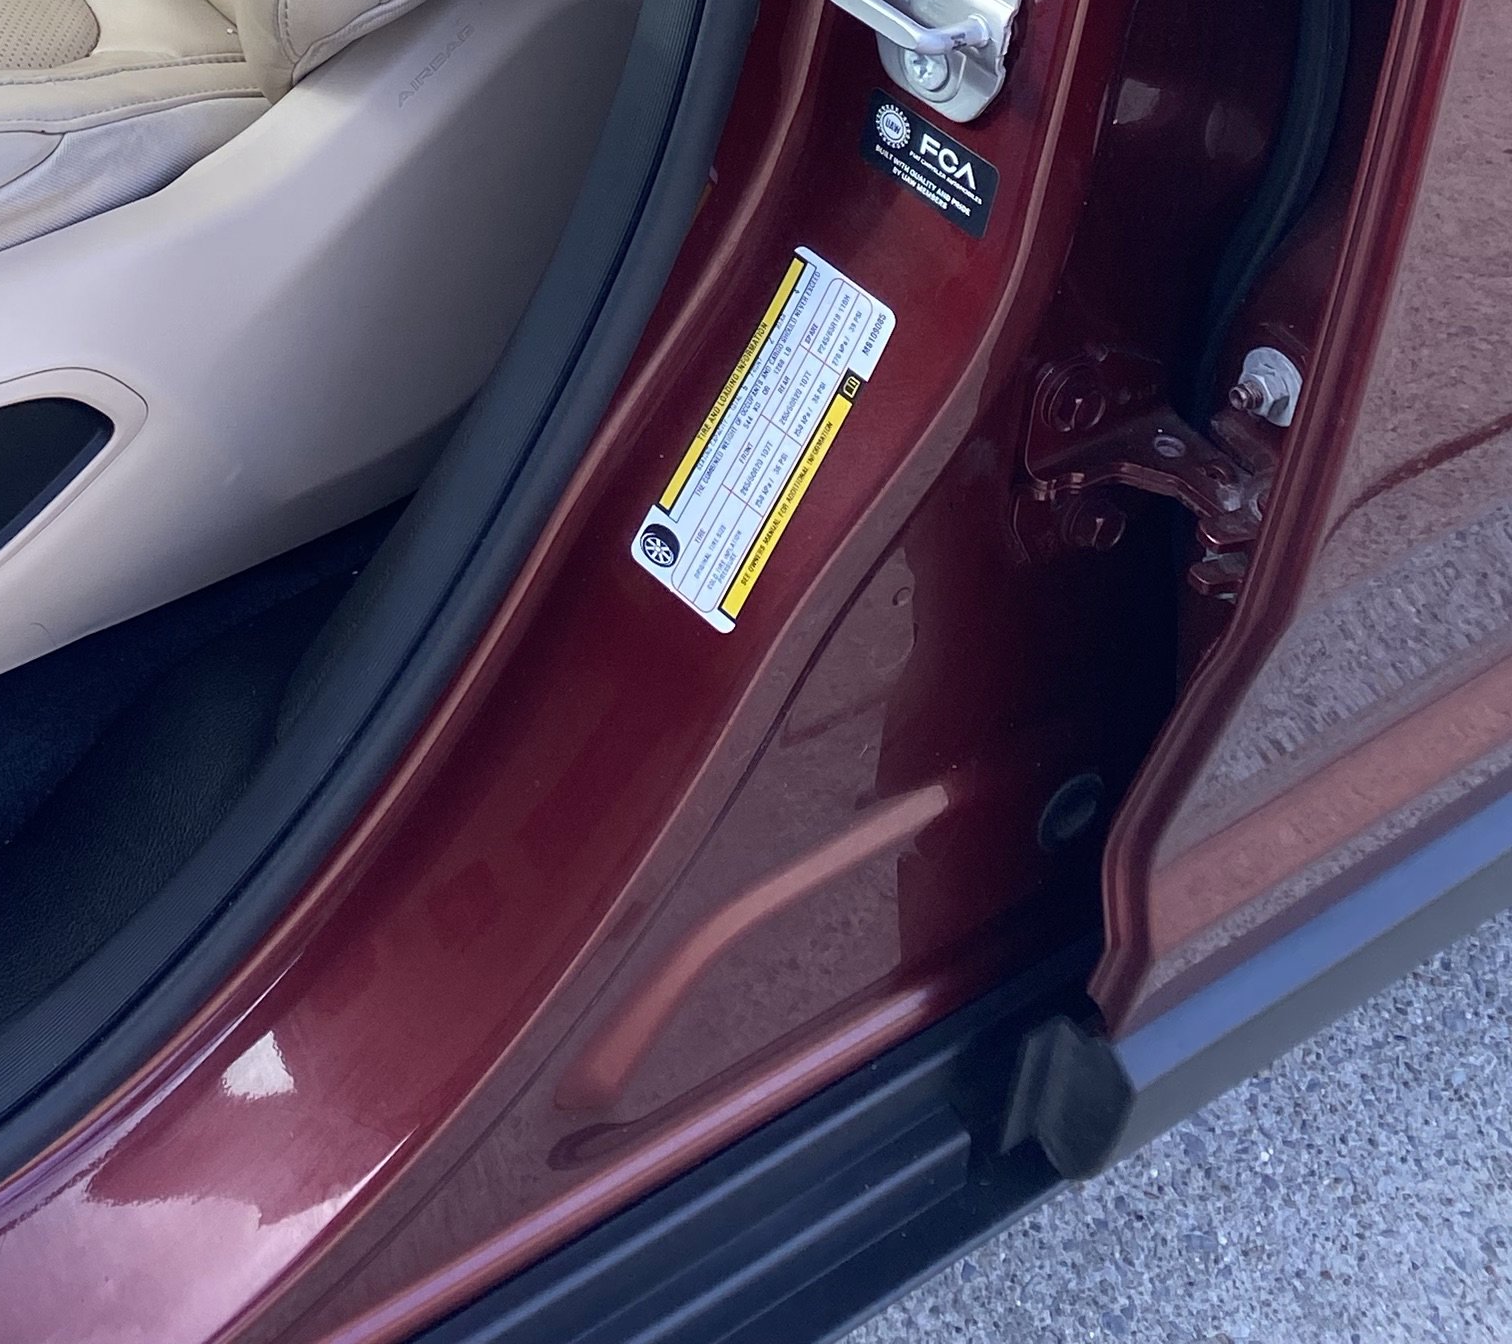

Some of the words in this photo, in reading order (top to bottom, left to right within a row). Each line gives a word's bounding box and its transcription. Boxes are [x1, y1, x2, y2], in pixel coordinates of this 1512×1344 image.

[398, 21, 475, 109] AIRBAG
[875, 144, 894, 160] BUILT
[893, 157, 910, 173] WITH
[909, 168, 937, 191] QUALITY
[936, 187, 951, 202] AND
[919, 133, 976, 190] FCA
[696, 423, 711, 441] TIRE
[706, 405, 721, 424] AND
[715, 372, 740, 406] LOADING
[734, 321, 769, 373] INFORMATION
[738, 378, 764, 416] OCCUPANTS
